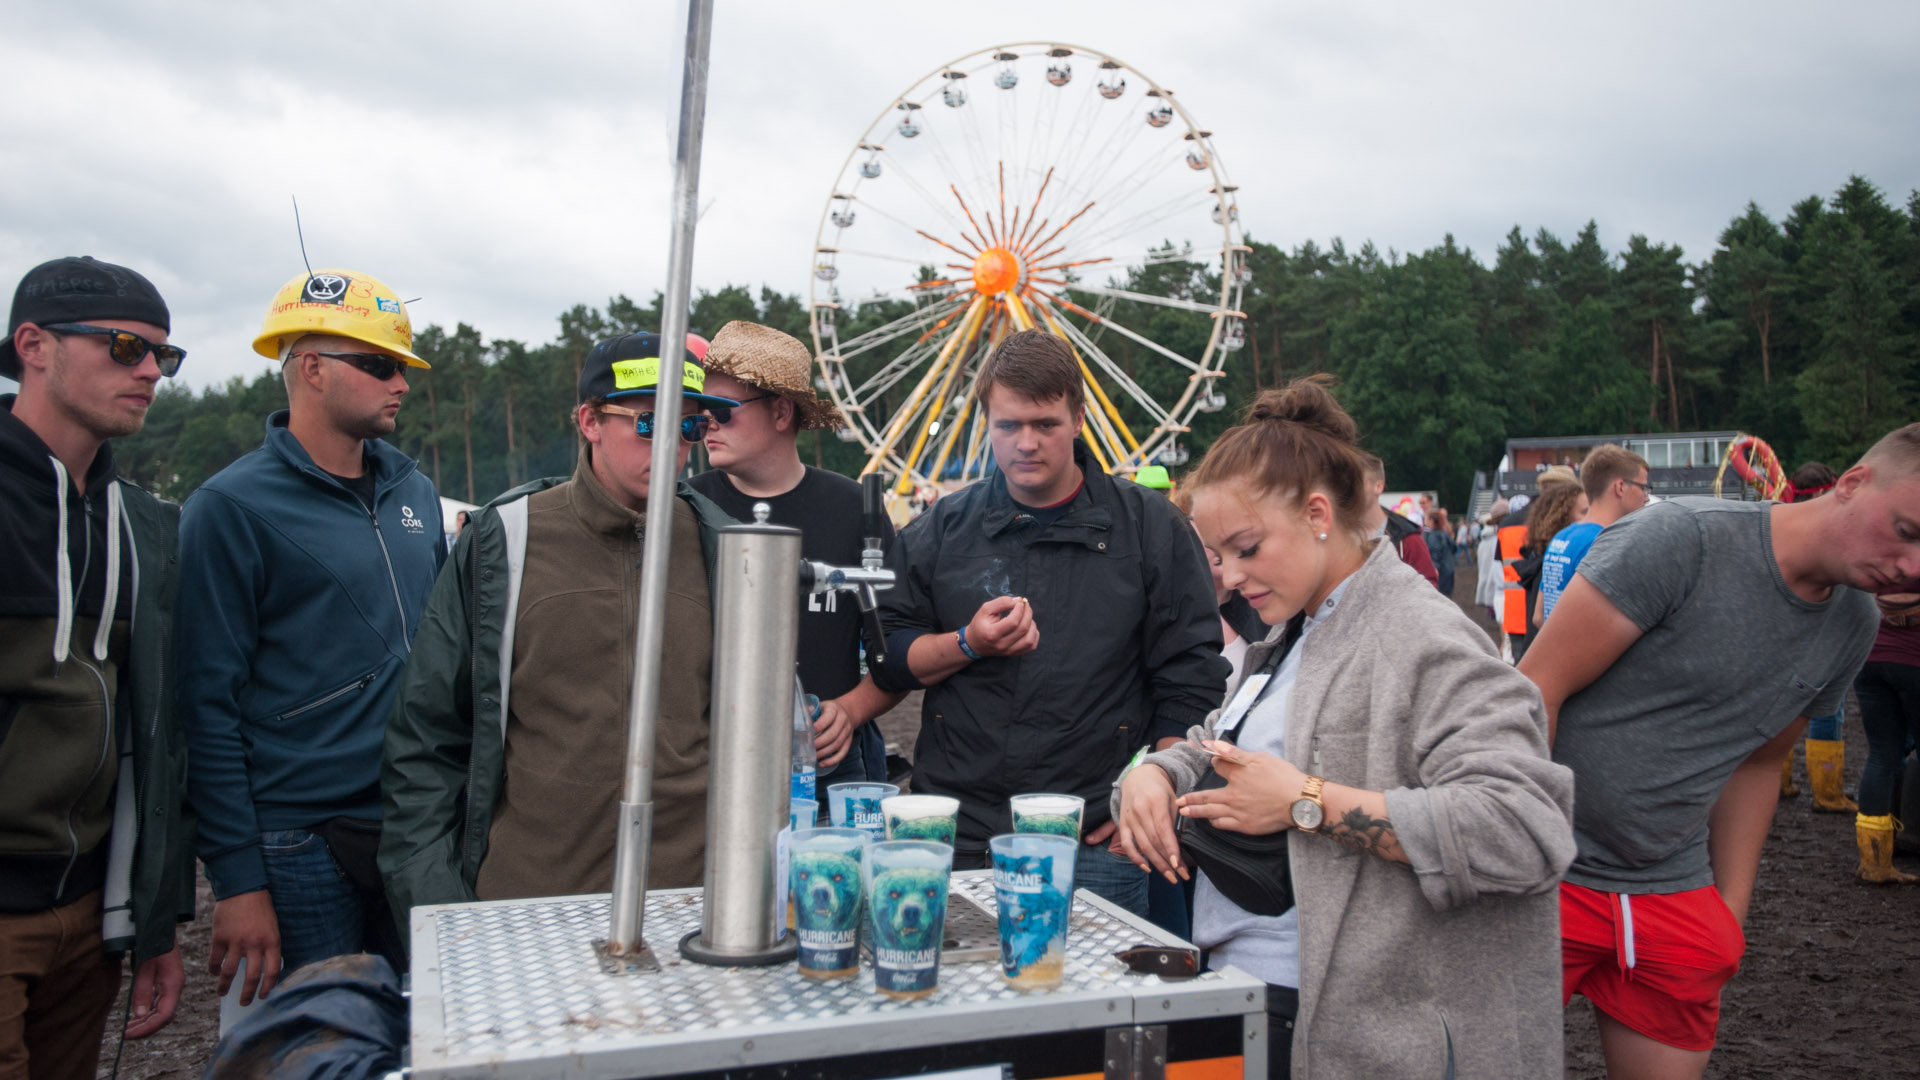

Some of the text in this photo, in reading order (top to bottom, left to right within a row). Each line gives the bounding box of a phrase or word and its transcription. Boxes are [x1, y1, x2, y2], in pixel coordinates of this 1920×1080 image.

[401, 518, 424, 528] CORE
[800, 928, 857, 944] HURRICANE
[876, 947, 937, 964] HURRICANE
